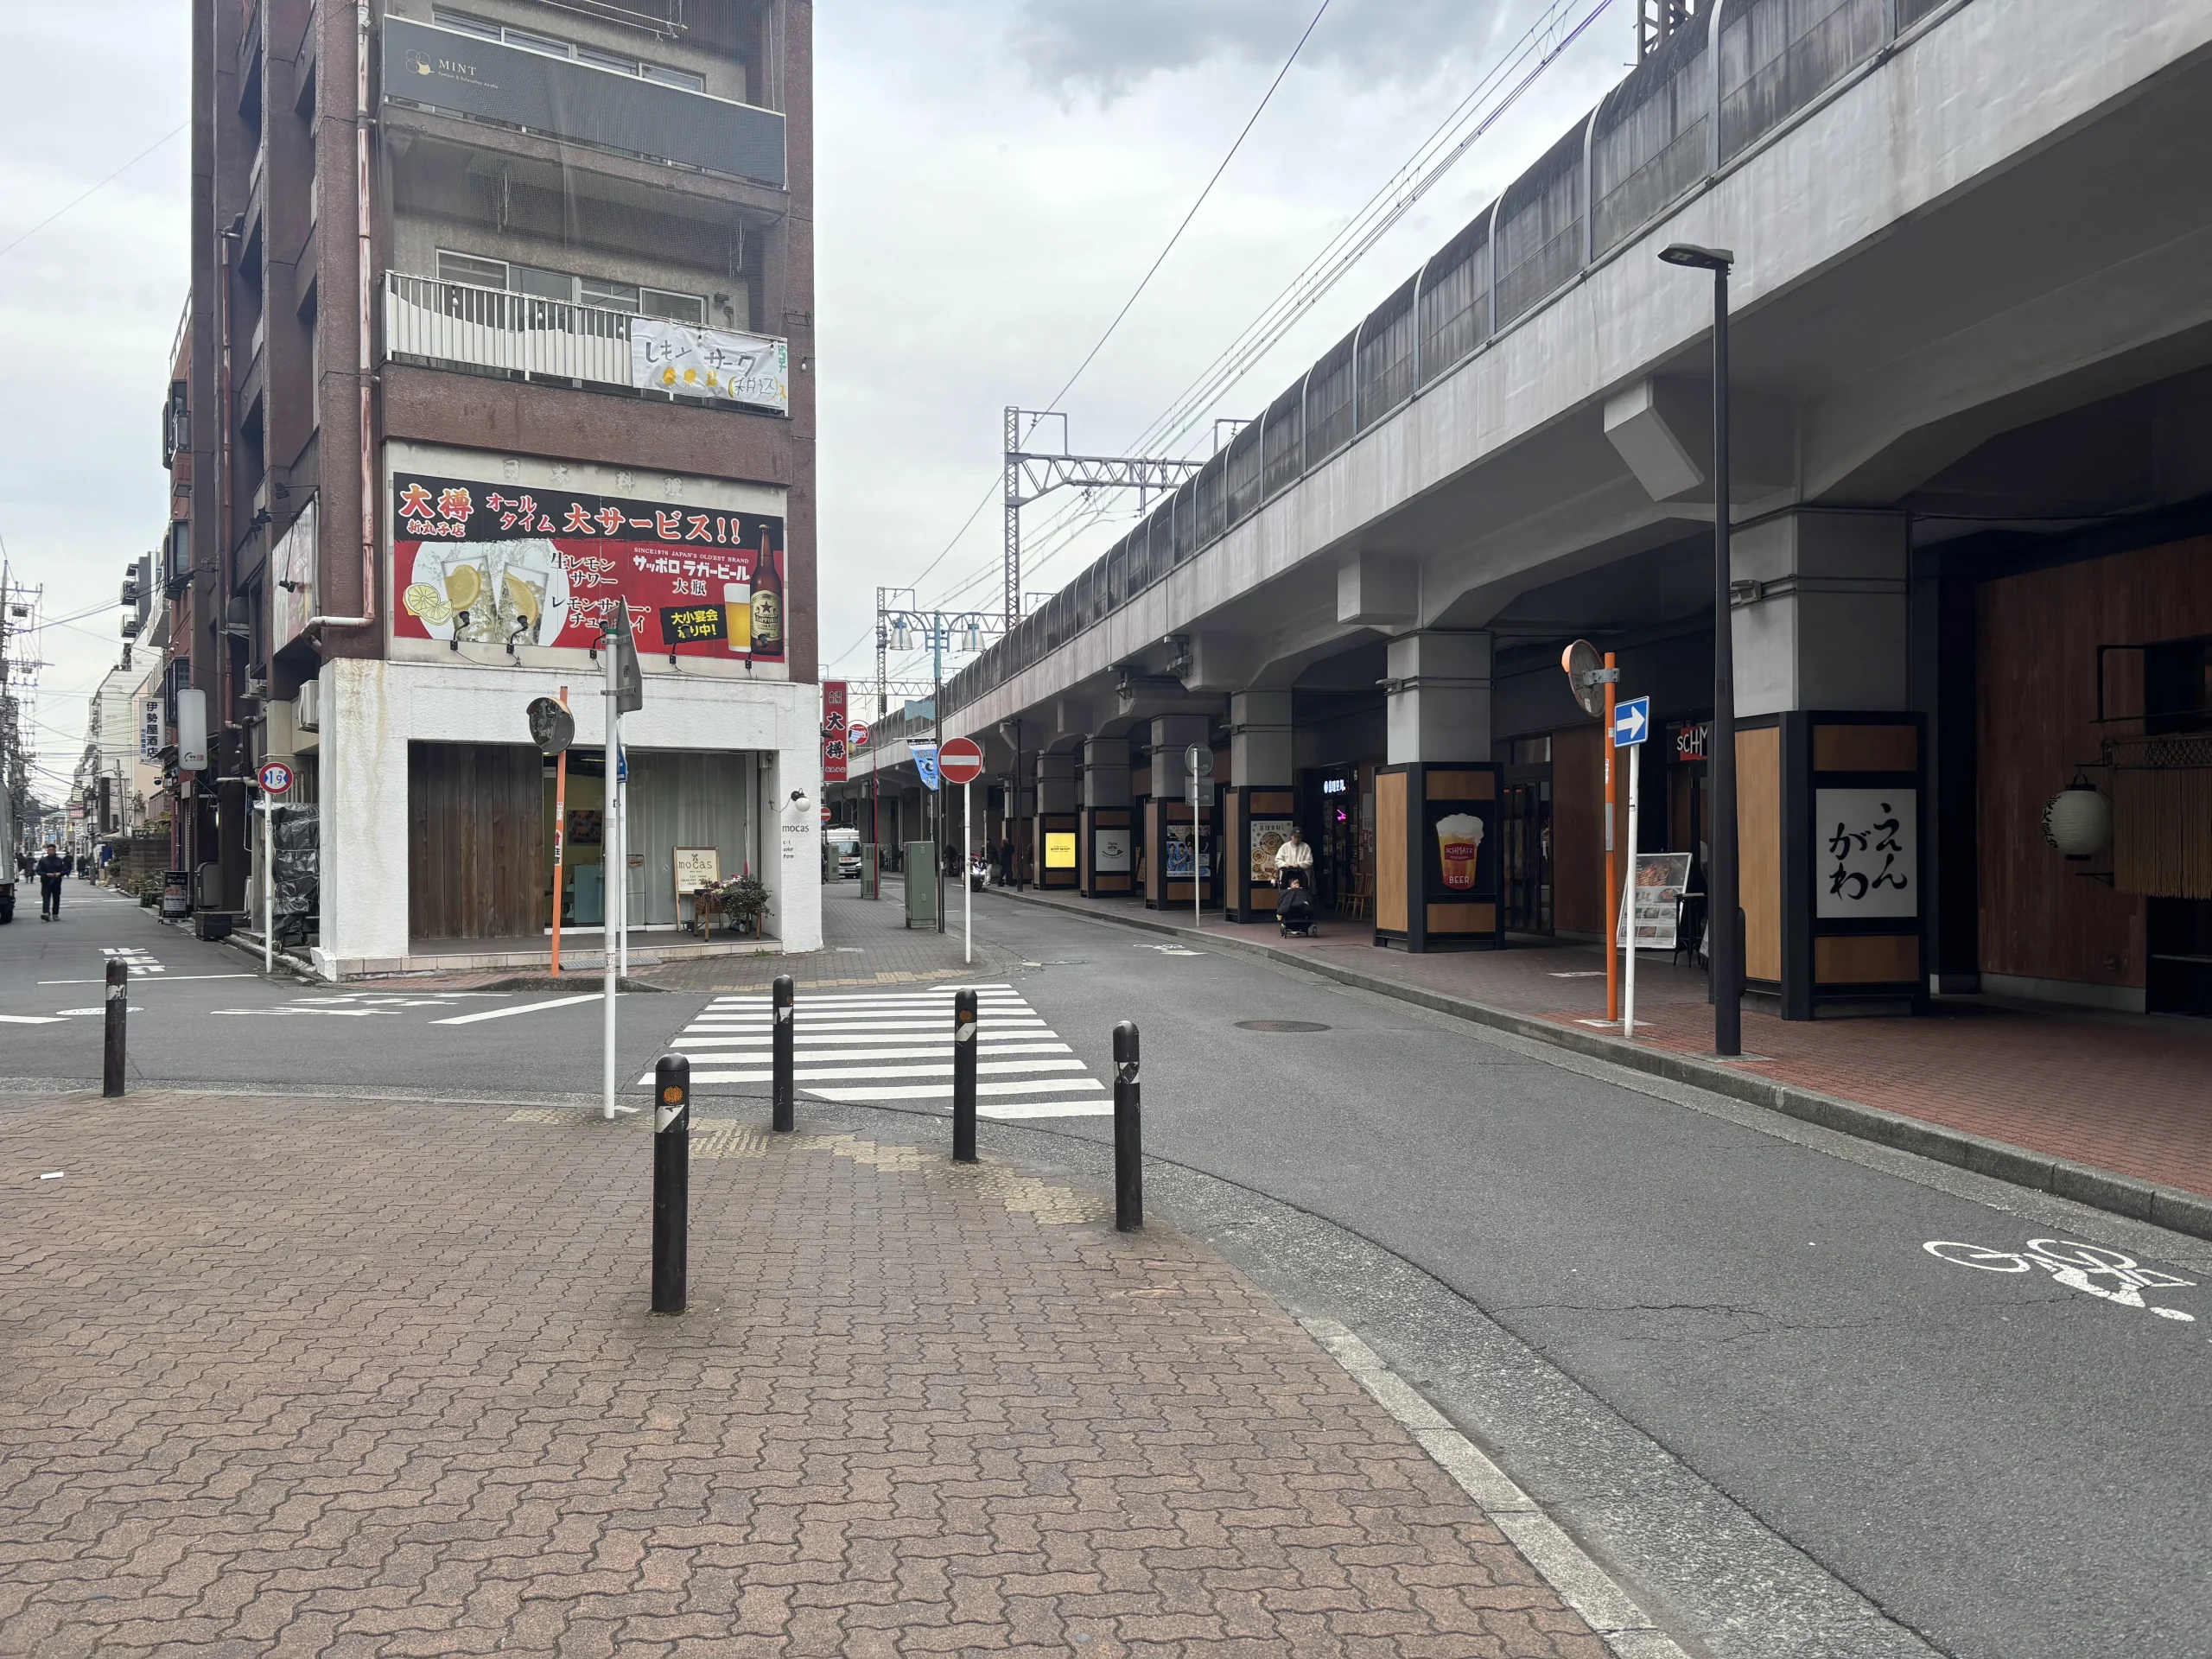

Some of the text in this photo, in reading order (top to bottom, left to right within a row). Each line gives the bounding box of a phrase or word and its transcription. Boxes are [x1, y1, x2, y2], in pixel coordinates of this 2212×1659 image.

[438, 59, 477, 76] MINT
[398, 483, 474, 522] 大樽
[486, 493, 537, 513] オール
[407, 518, 467, 537] 新丸子店
[500, 512, 556, 533] タイム
[550, 550, 616, 572] 生レモン
[671, 550, 697, 559] JAPAN'S
[632, 555, 751, 582] サッポロ ラガービール
[570, 570, 619, 588] サワー
[671, 578, 707, 596] 大瓶
[551, 596, 652, 615] レモンサー・
[570, 612, 645, 633] チュイ
[671, 608, 719, 626] 大小宴会
[146, 701, 159, 758] 伊勢屋酒店
[825, 711, 846, 760] 大樽
[1446, 846, 1473, 855] SCHMATZ
[678, 861, 713, 869] mocas
[1449, 875, 1470, 884] BEER
